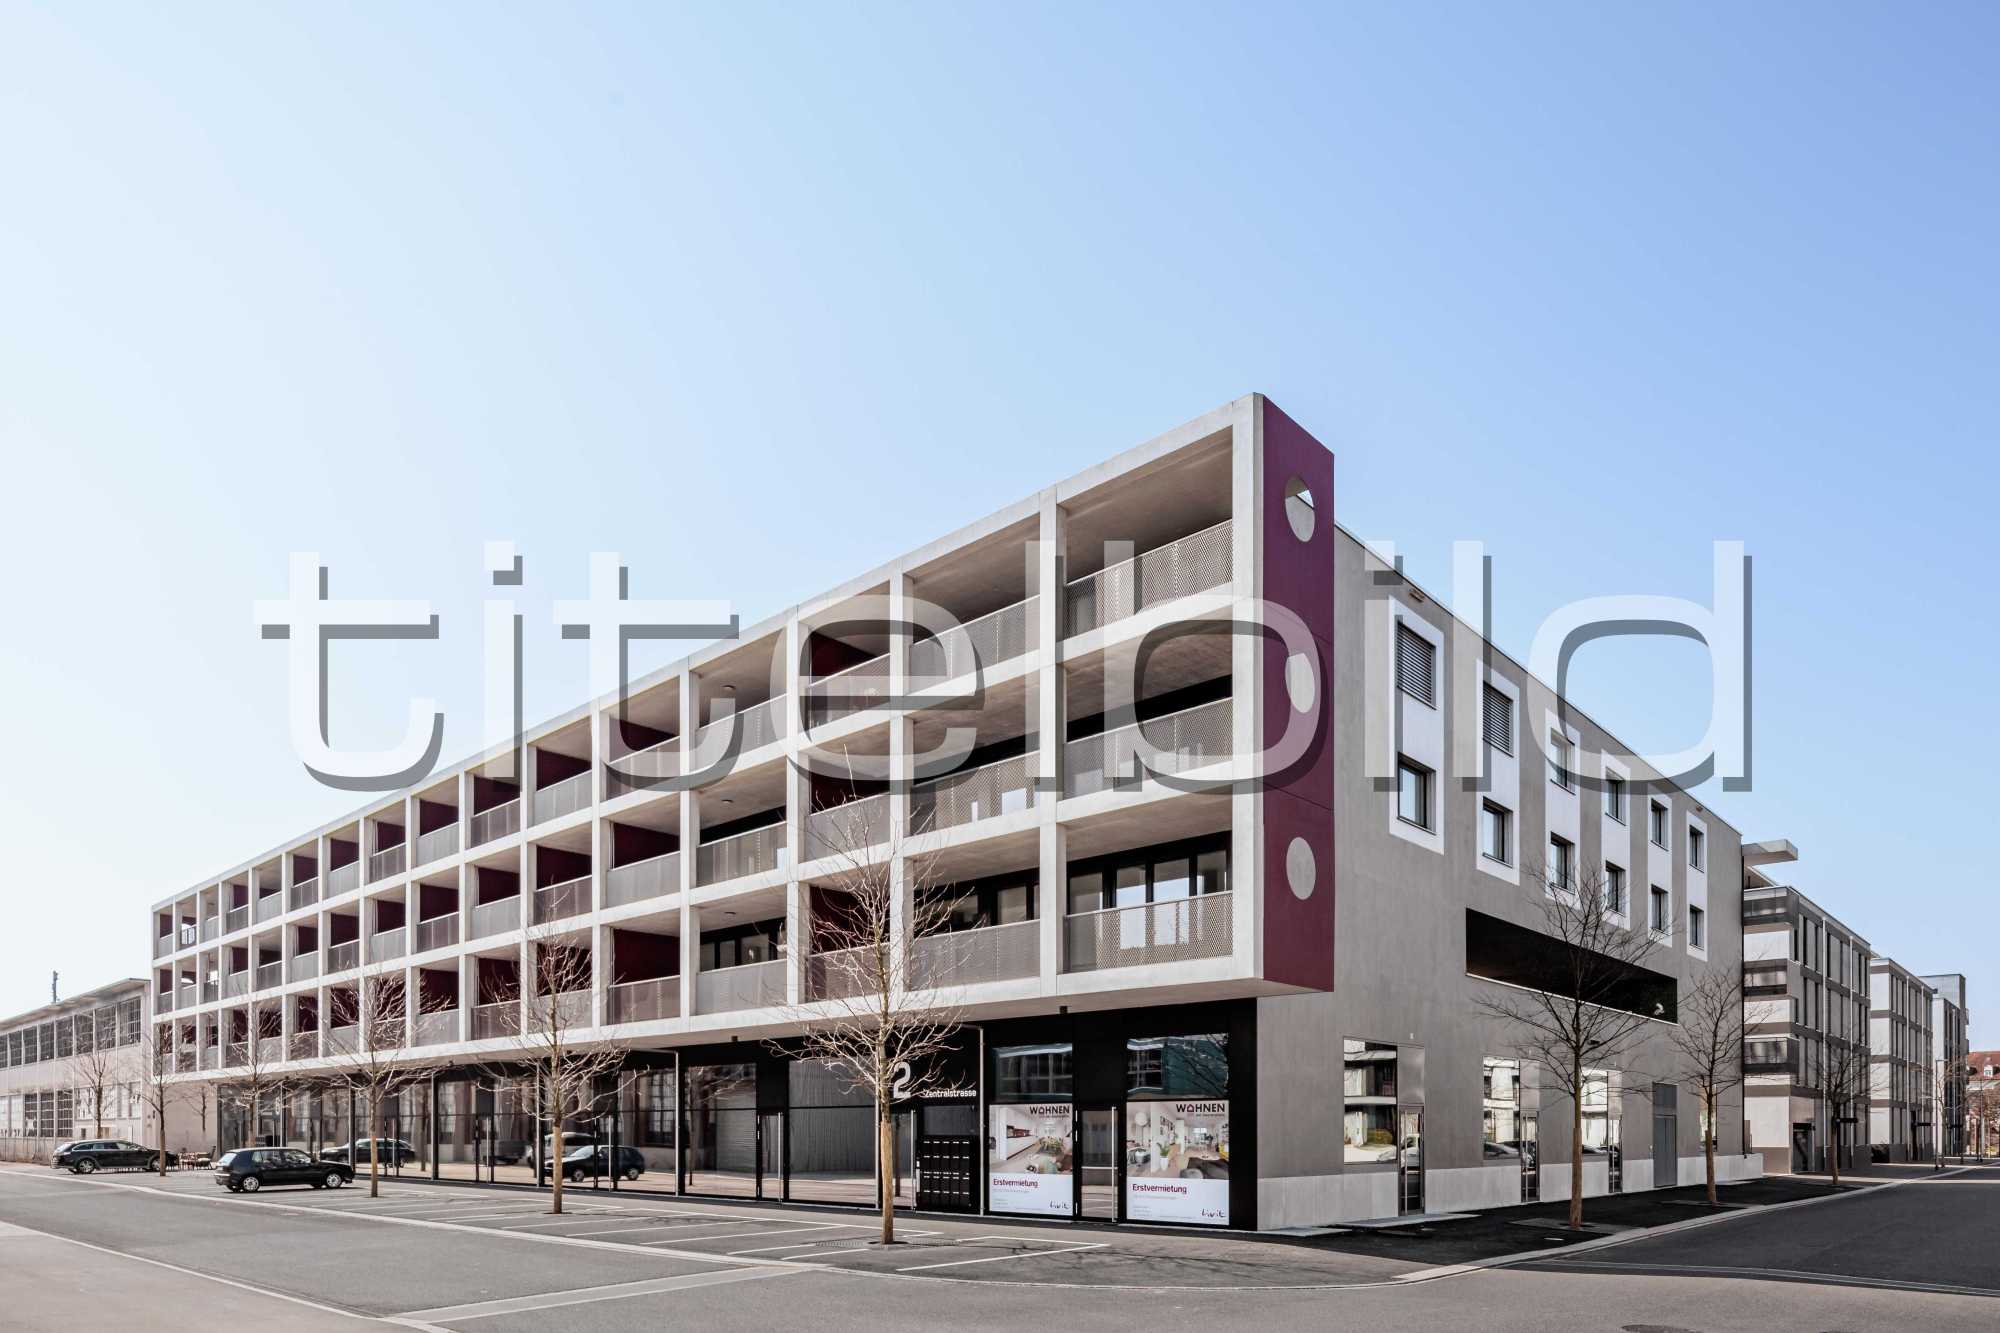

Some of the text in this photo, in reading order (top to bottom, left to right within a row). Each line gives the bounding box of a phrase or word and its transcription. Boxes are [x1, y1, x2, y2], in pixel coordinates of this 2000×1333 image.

[893, 1061, 911, 1099] 2
[925, 1088, 977, 1098] Zentralstrasse
[1029, 1105, 1070, 1115] WOHNEN
[1175, 1103, 1225, 1113] WOHNEN
[993, 1178, 1039, 1189] Erstvermietung
[1132, 1183, 1187, 1195] Erstvermietung
